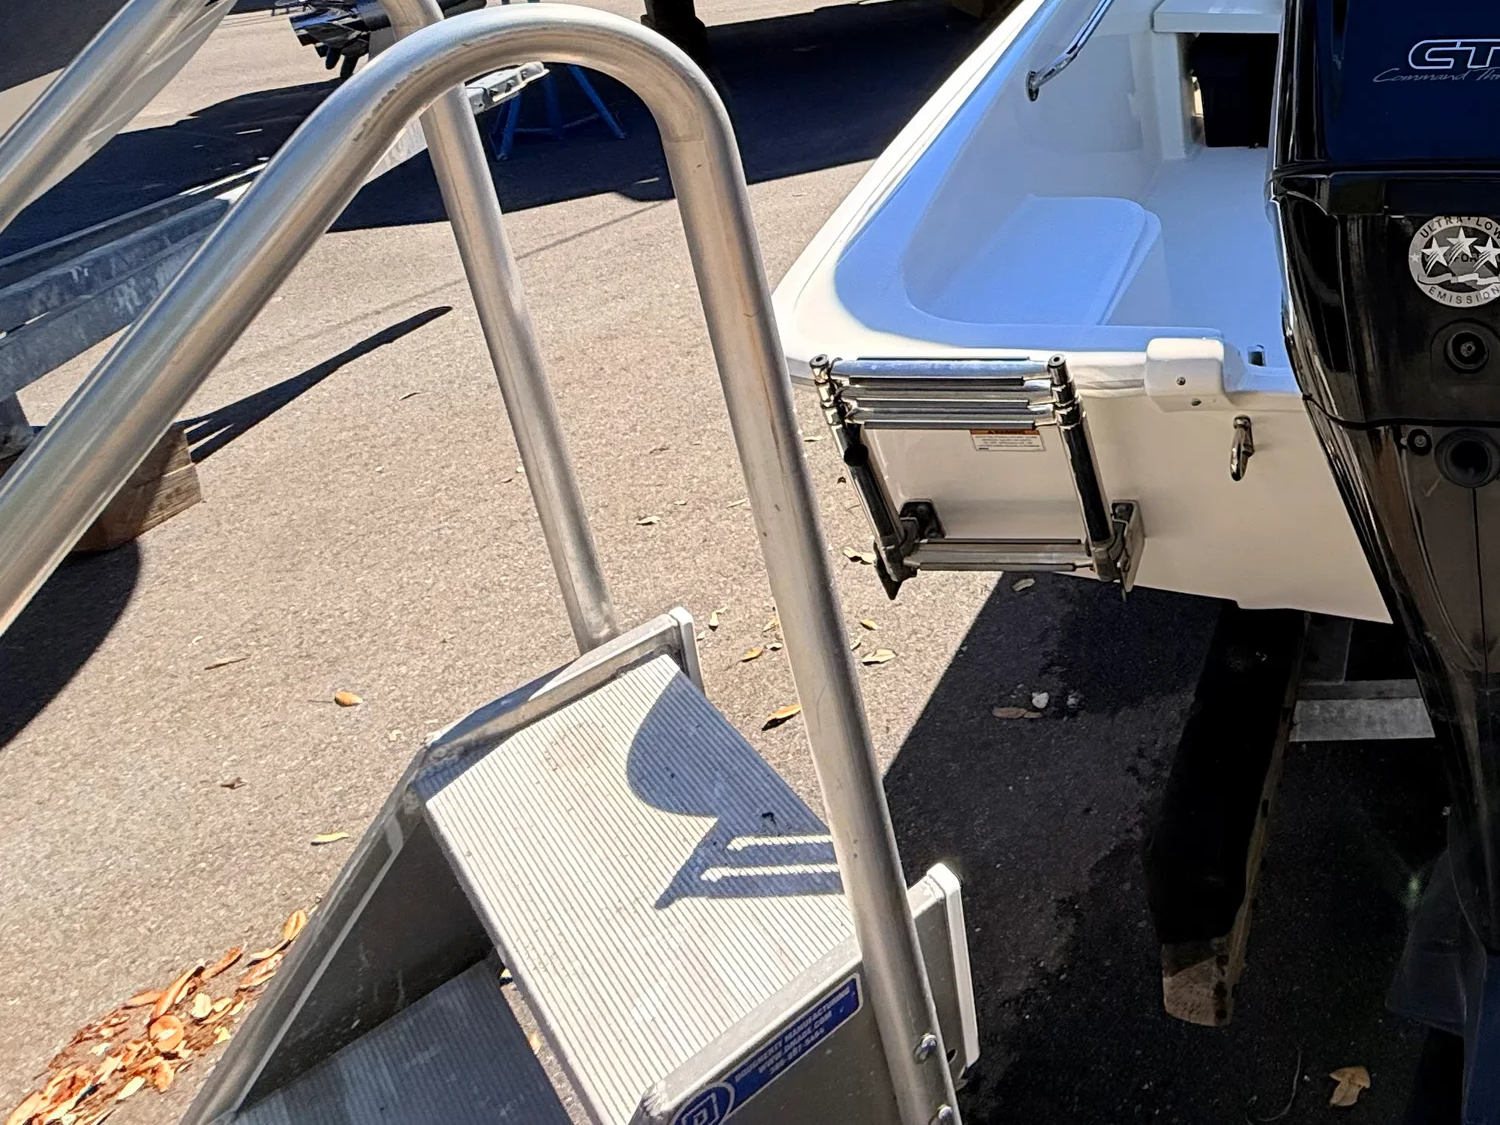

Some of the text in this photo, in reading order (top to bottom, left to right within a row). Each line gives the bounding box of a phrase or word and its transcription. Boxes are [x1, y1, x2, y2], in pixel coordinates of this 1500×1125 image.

[1373, 67, 1469, 83] Command
[1419, 215, 1463, 239] ULTRA
[784, 986, 850, 1044] MANUFACTURING
